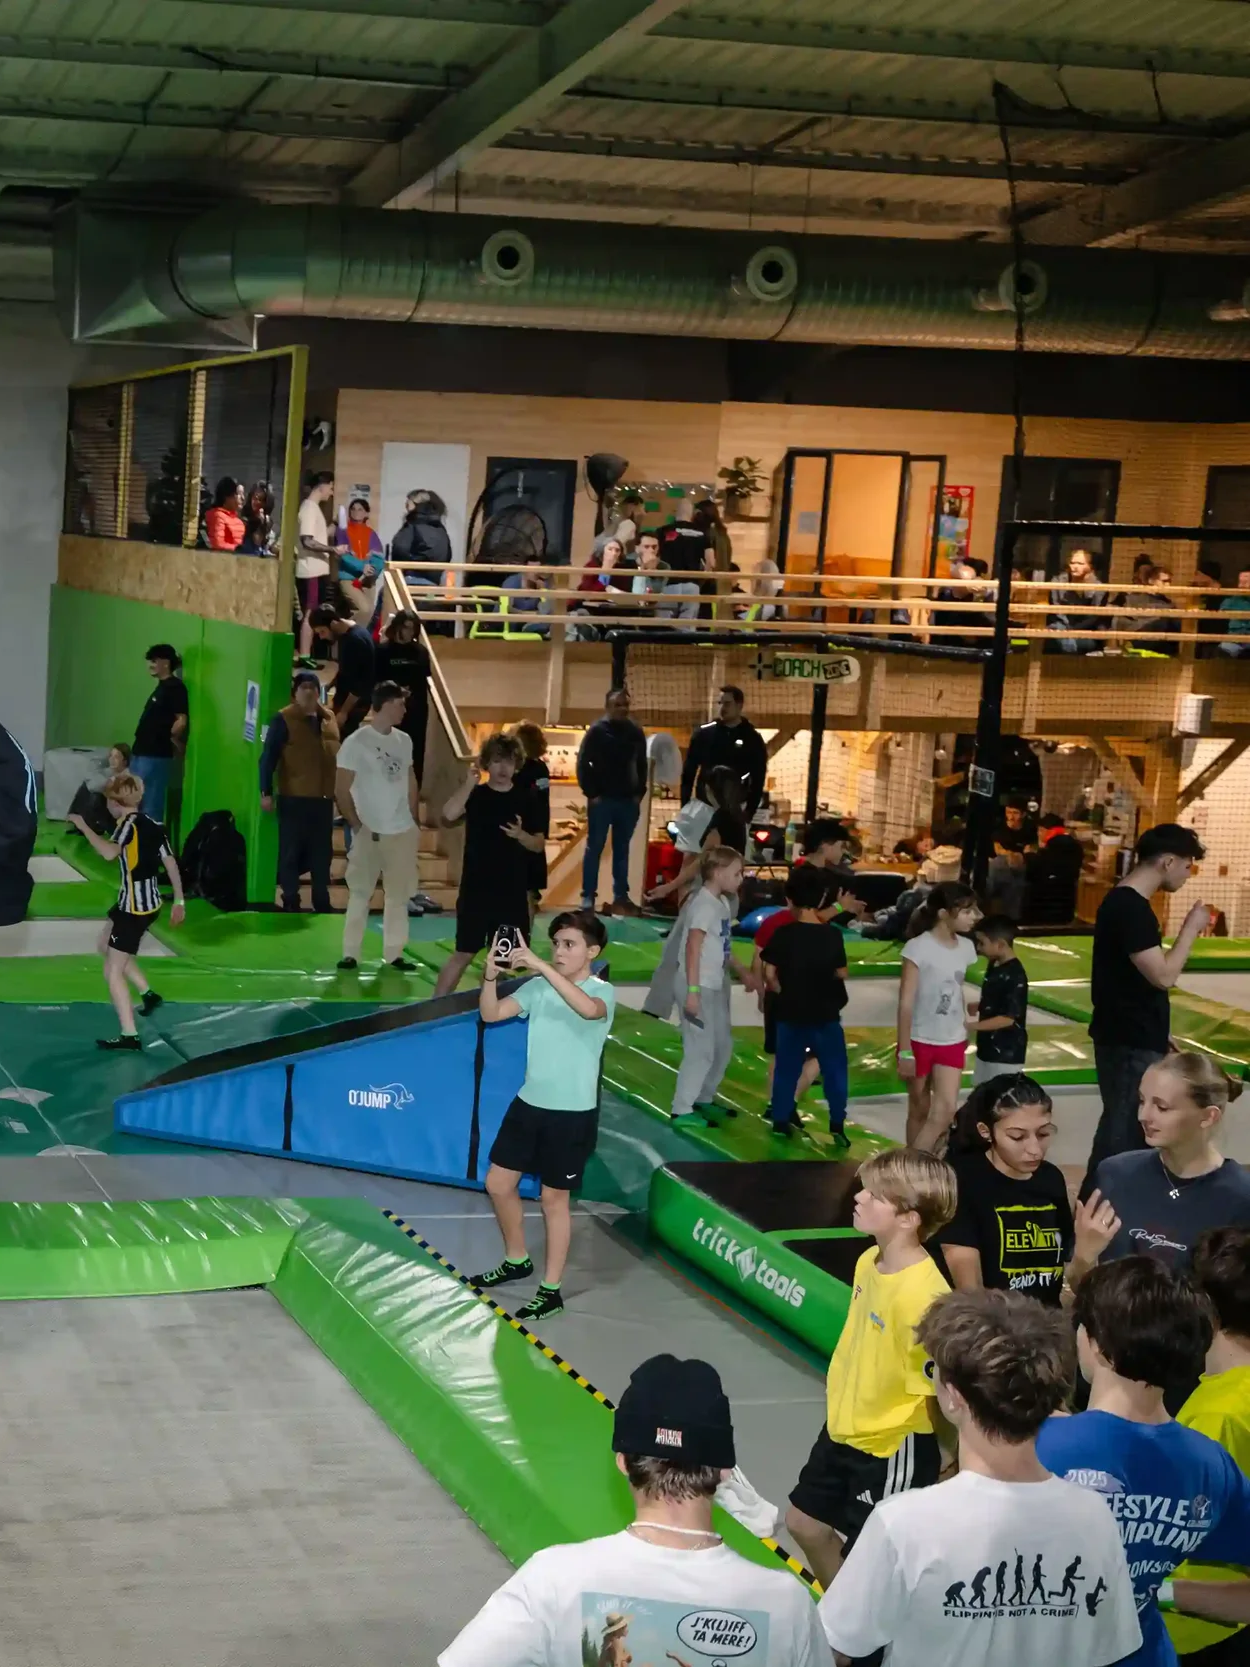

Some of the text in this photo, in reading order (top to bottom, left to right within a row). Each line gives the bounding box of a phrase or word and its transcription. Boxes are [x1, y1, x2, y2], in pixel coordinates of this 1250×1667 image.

[692, 1217, 806, 1307] trick tools
[1010, 1273, 1037, 1290] SEND
[1069, 1469, 1107, 1487] 2025
[1009, 1608, 1026, 1617] NOT
[1041, 1608, 1074, 1617] CRIME
[692, 1630, 706, 1641] TA
